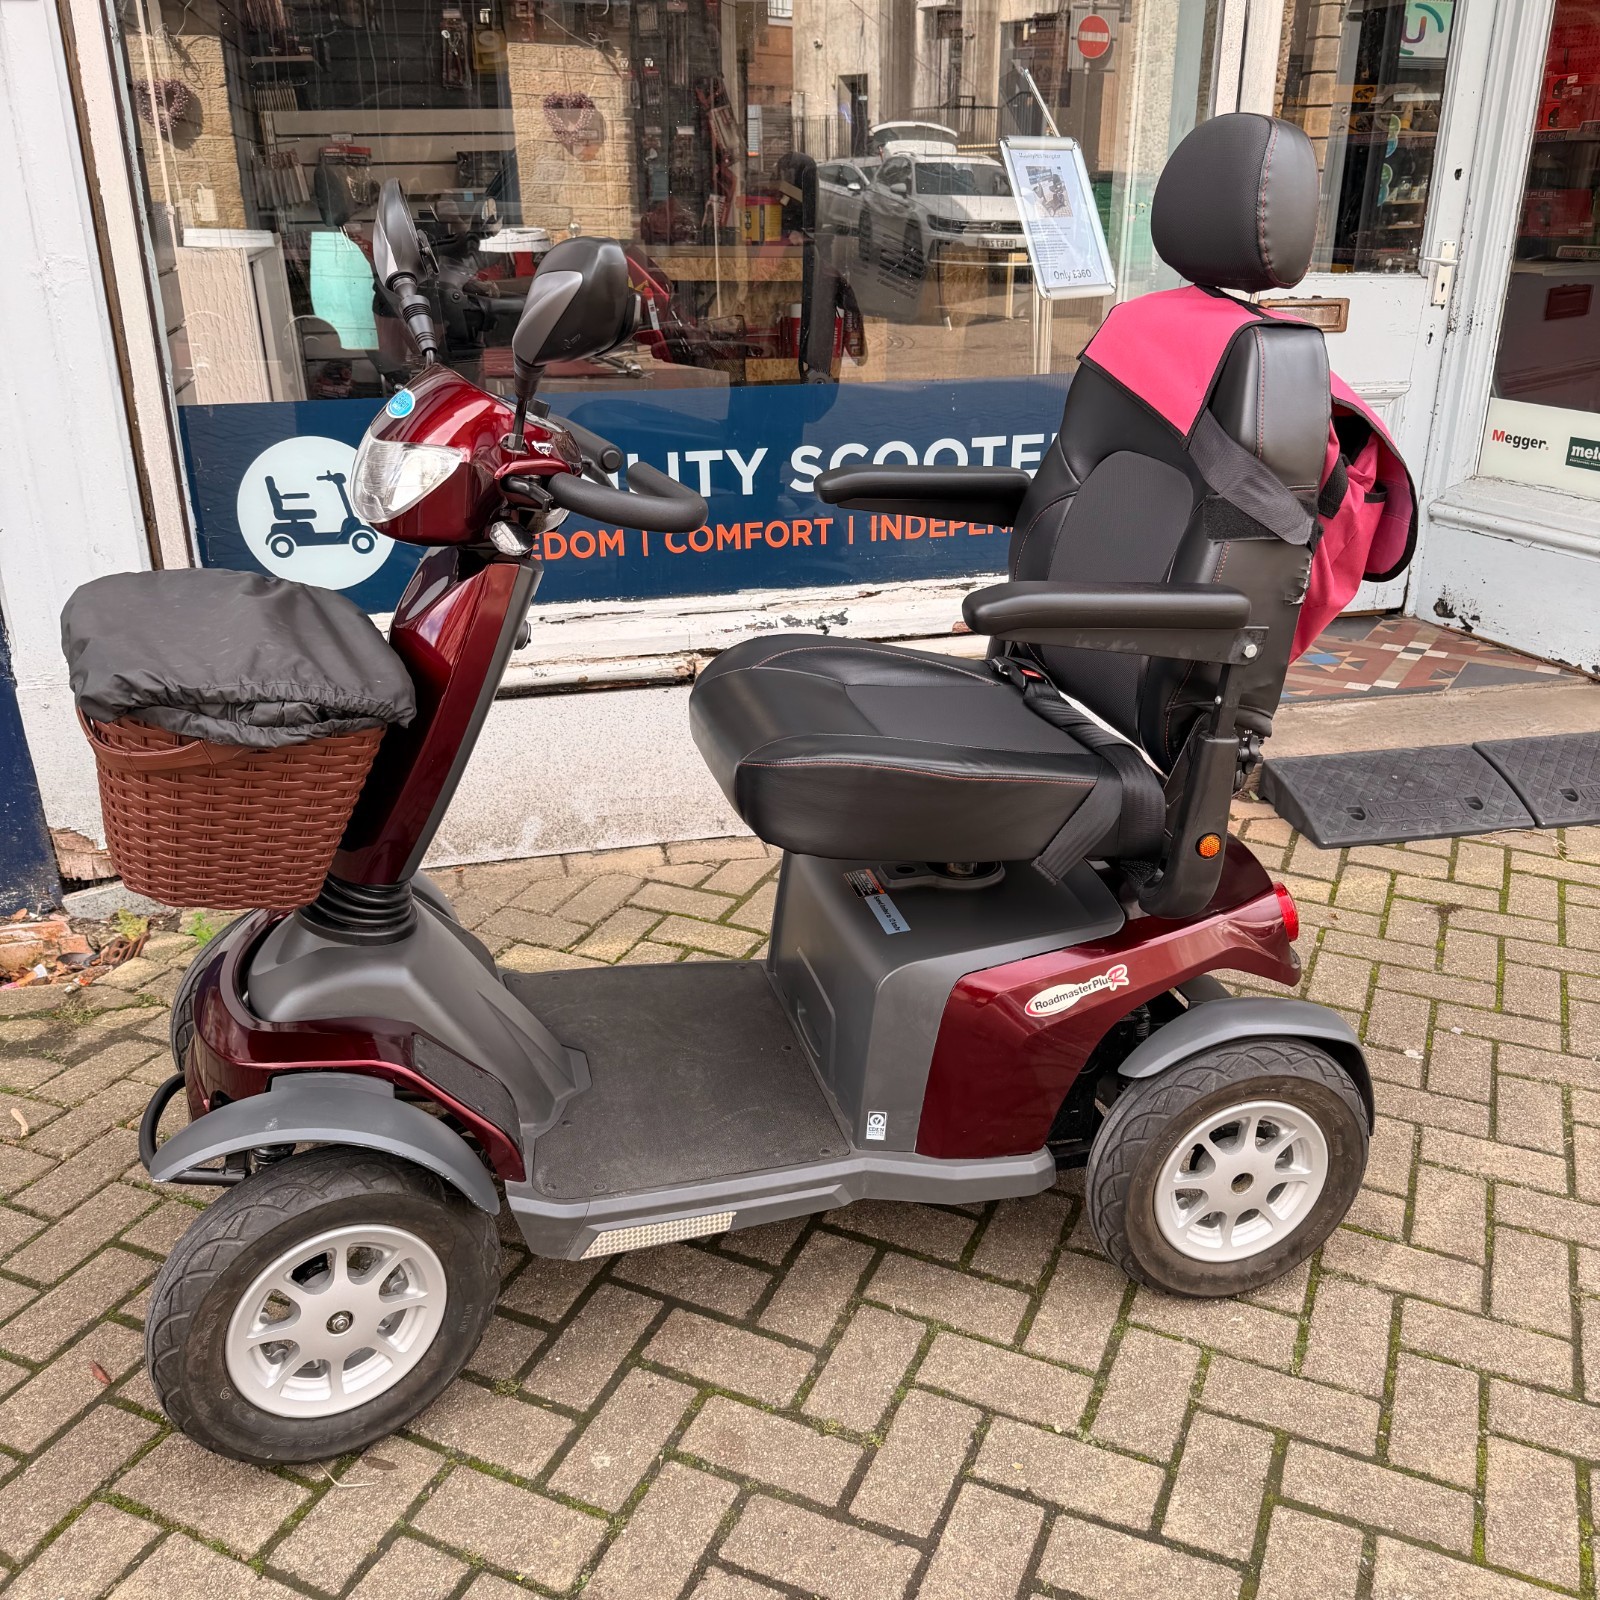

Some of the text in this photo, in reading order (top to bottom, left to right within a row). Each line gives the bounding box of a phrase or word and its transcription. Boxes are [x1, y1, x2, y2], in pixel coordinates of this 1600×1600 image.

[1053, 268, 1092, 281] Only £360
[790, 433, 1057, 493] SCOOTE
[1570, 445, 1600, 460] met
[664, 517, 834, 554] COMFORT
